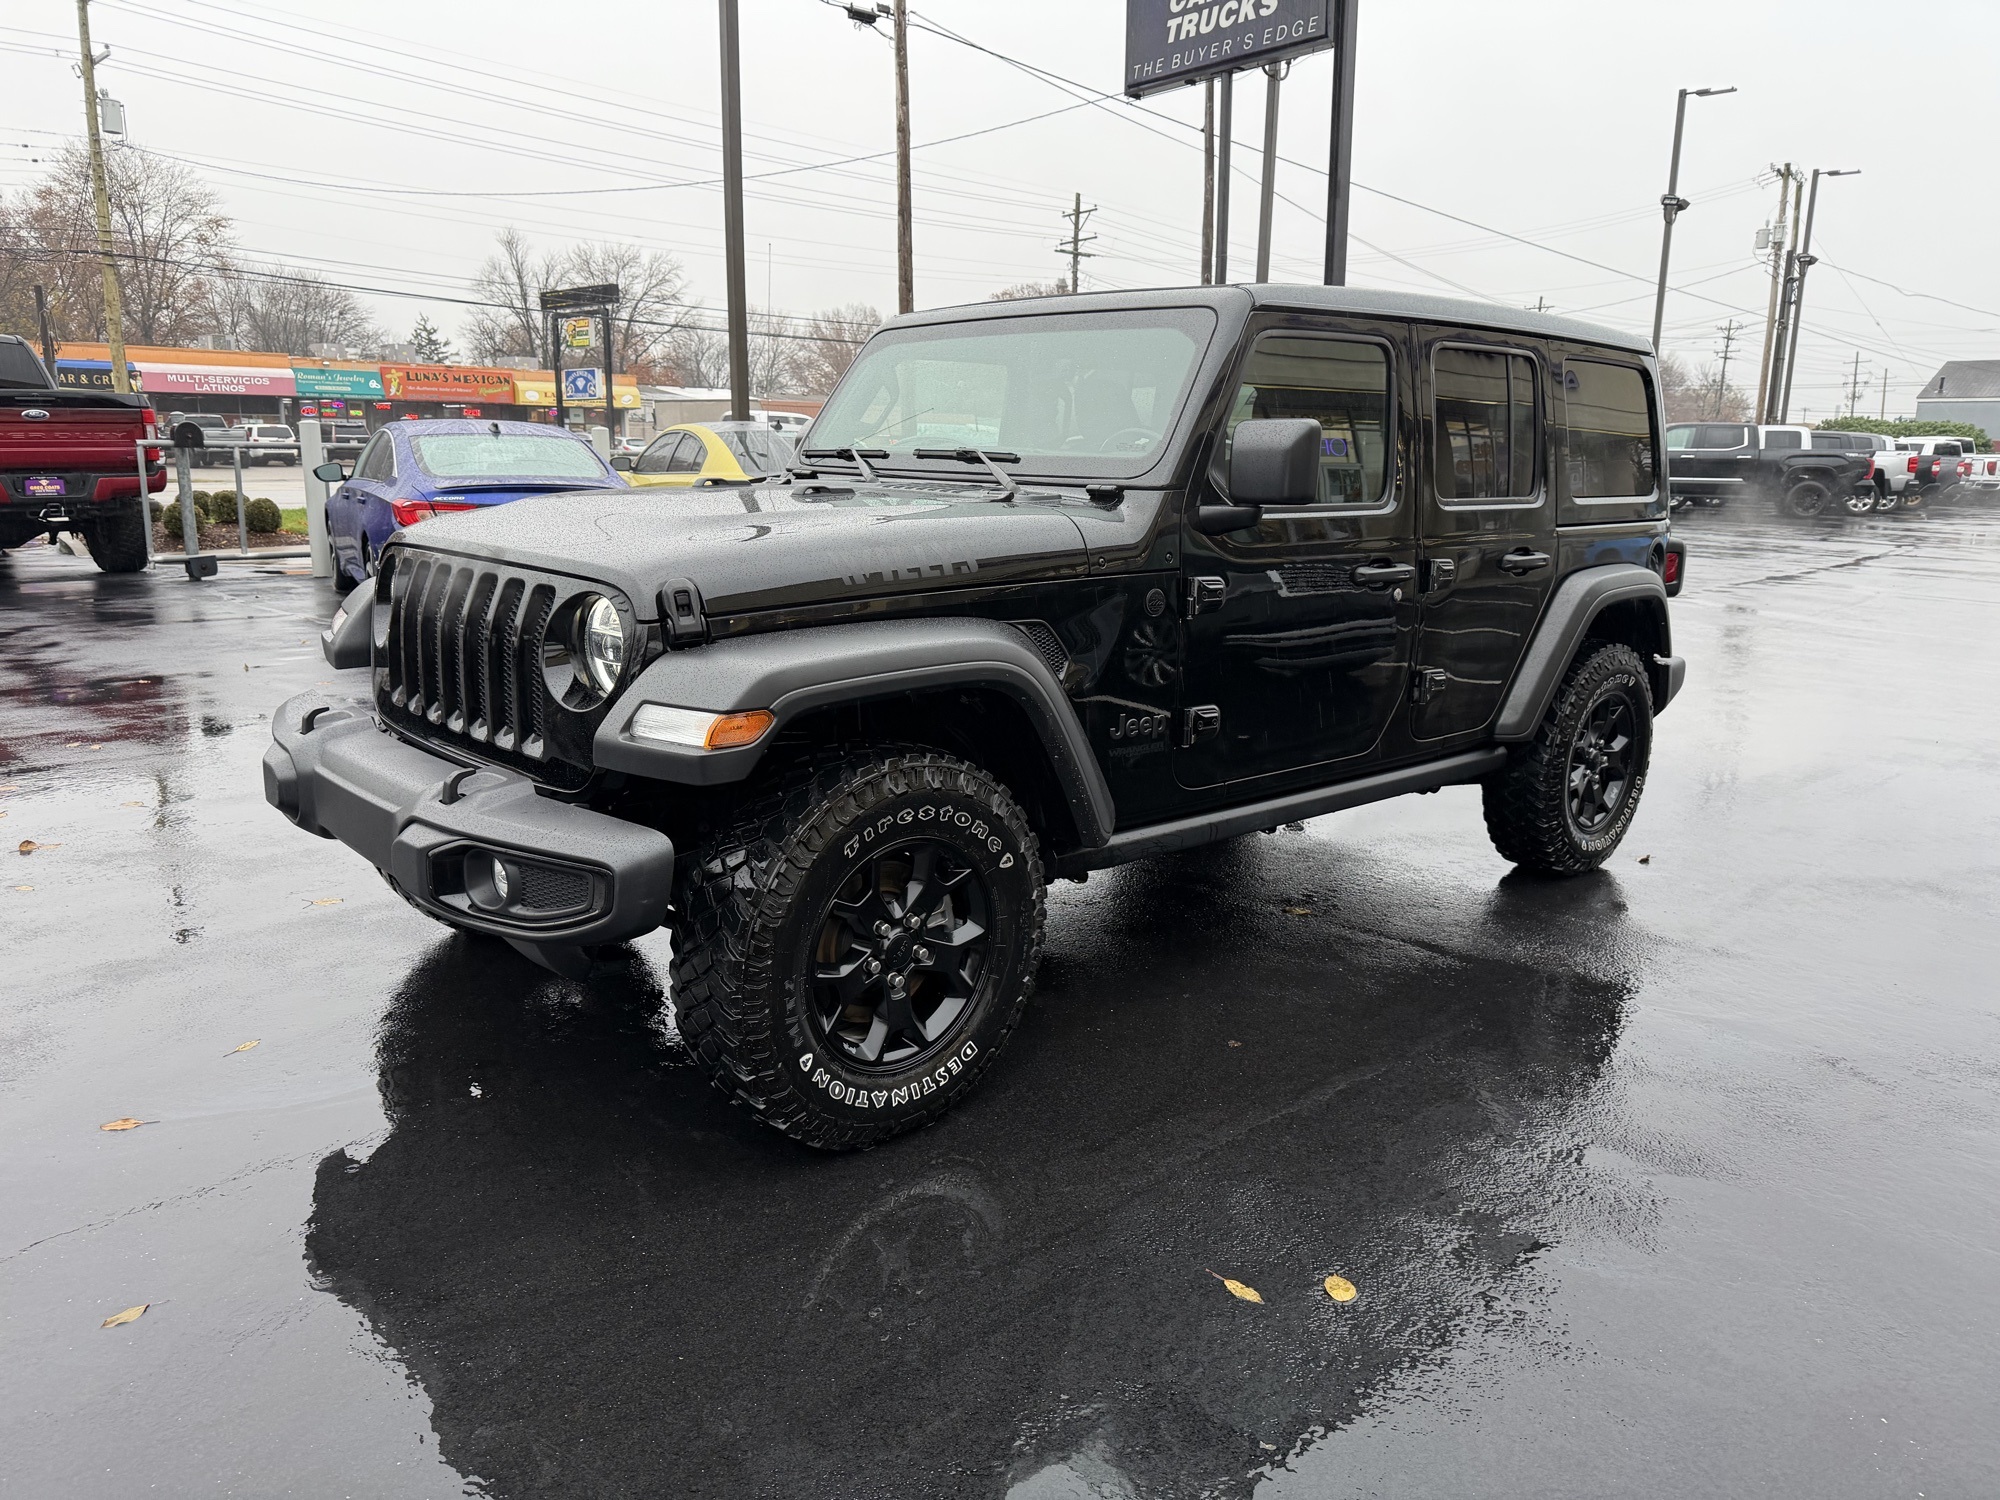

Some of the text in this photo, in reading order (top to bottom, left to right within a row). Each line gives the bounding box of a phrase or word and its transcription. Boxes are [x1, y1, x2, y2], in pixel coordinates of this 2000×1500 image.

[1167, 0, 1278, 44] TRUCKS
[1133, 15, 1319, 79] THE BUYER'S EDGE
[58, 373, 76, 384] AR
[80, 374, 89, 385] &
[166, 374, 270, 386] MULTI-SERVICIOS
[297, 371, 365, 383] Roman's Jewelry
[405, 371, 511, 386] LUNA'S MEXICAN
[194, 383, 246, 393] LATINOS
[1109, 713, 1166, 739] Jeep
[842, 805, 1003, 859] Firestone
[812, 1040, 979, 1108] DESTINATION
